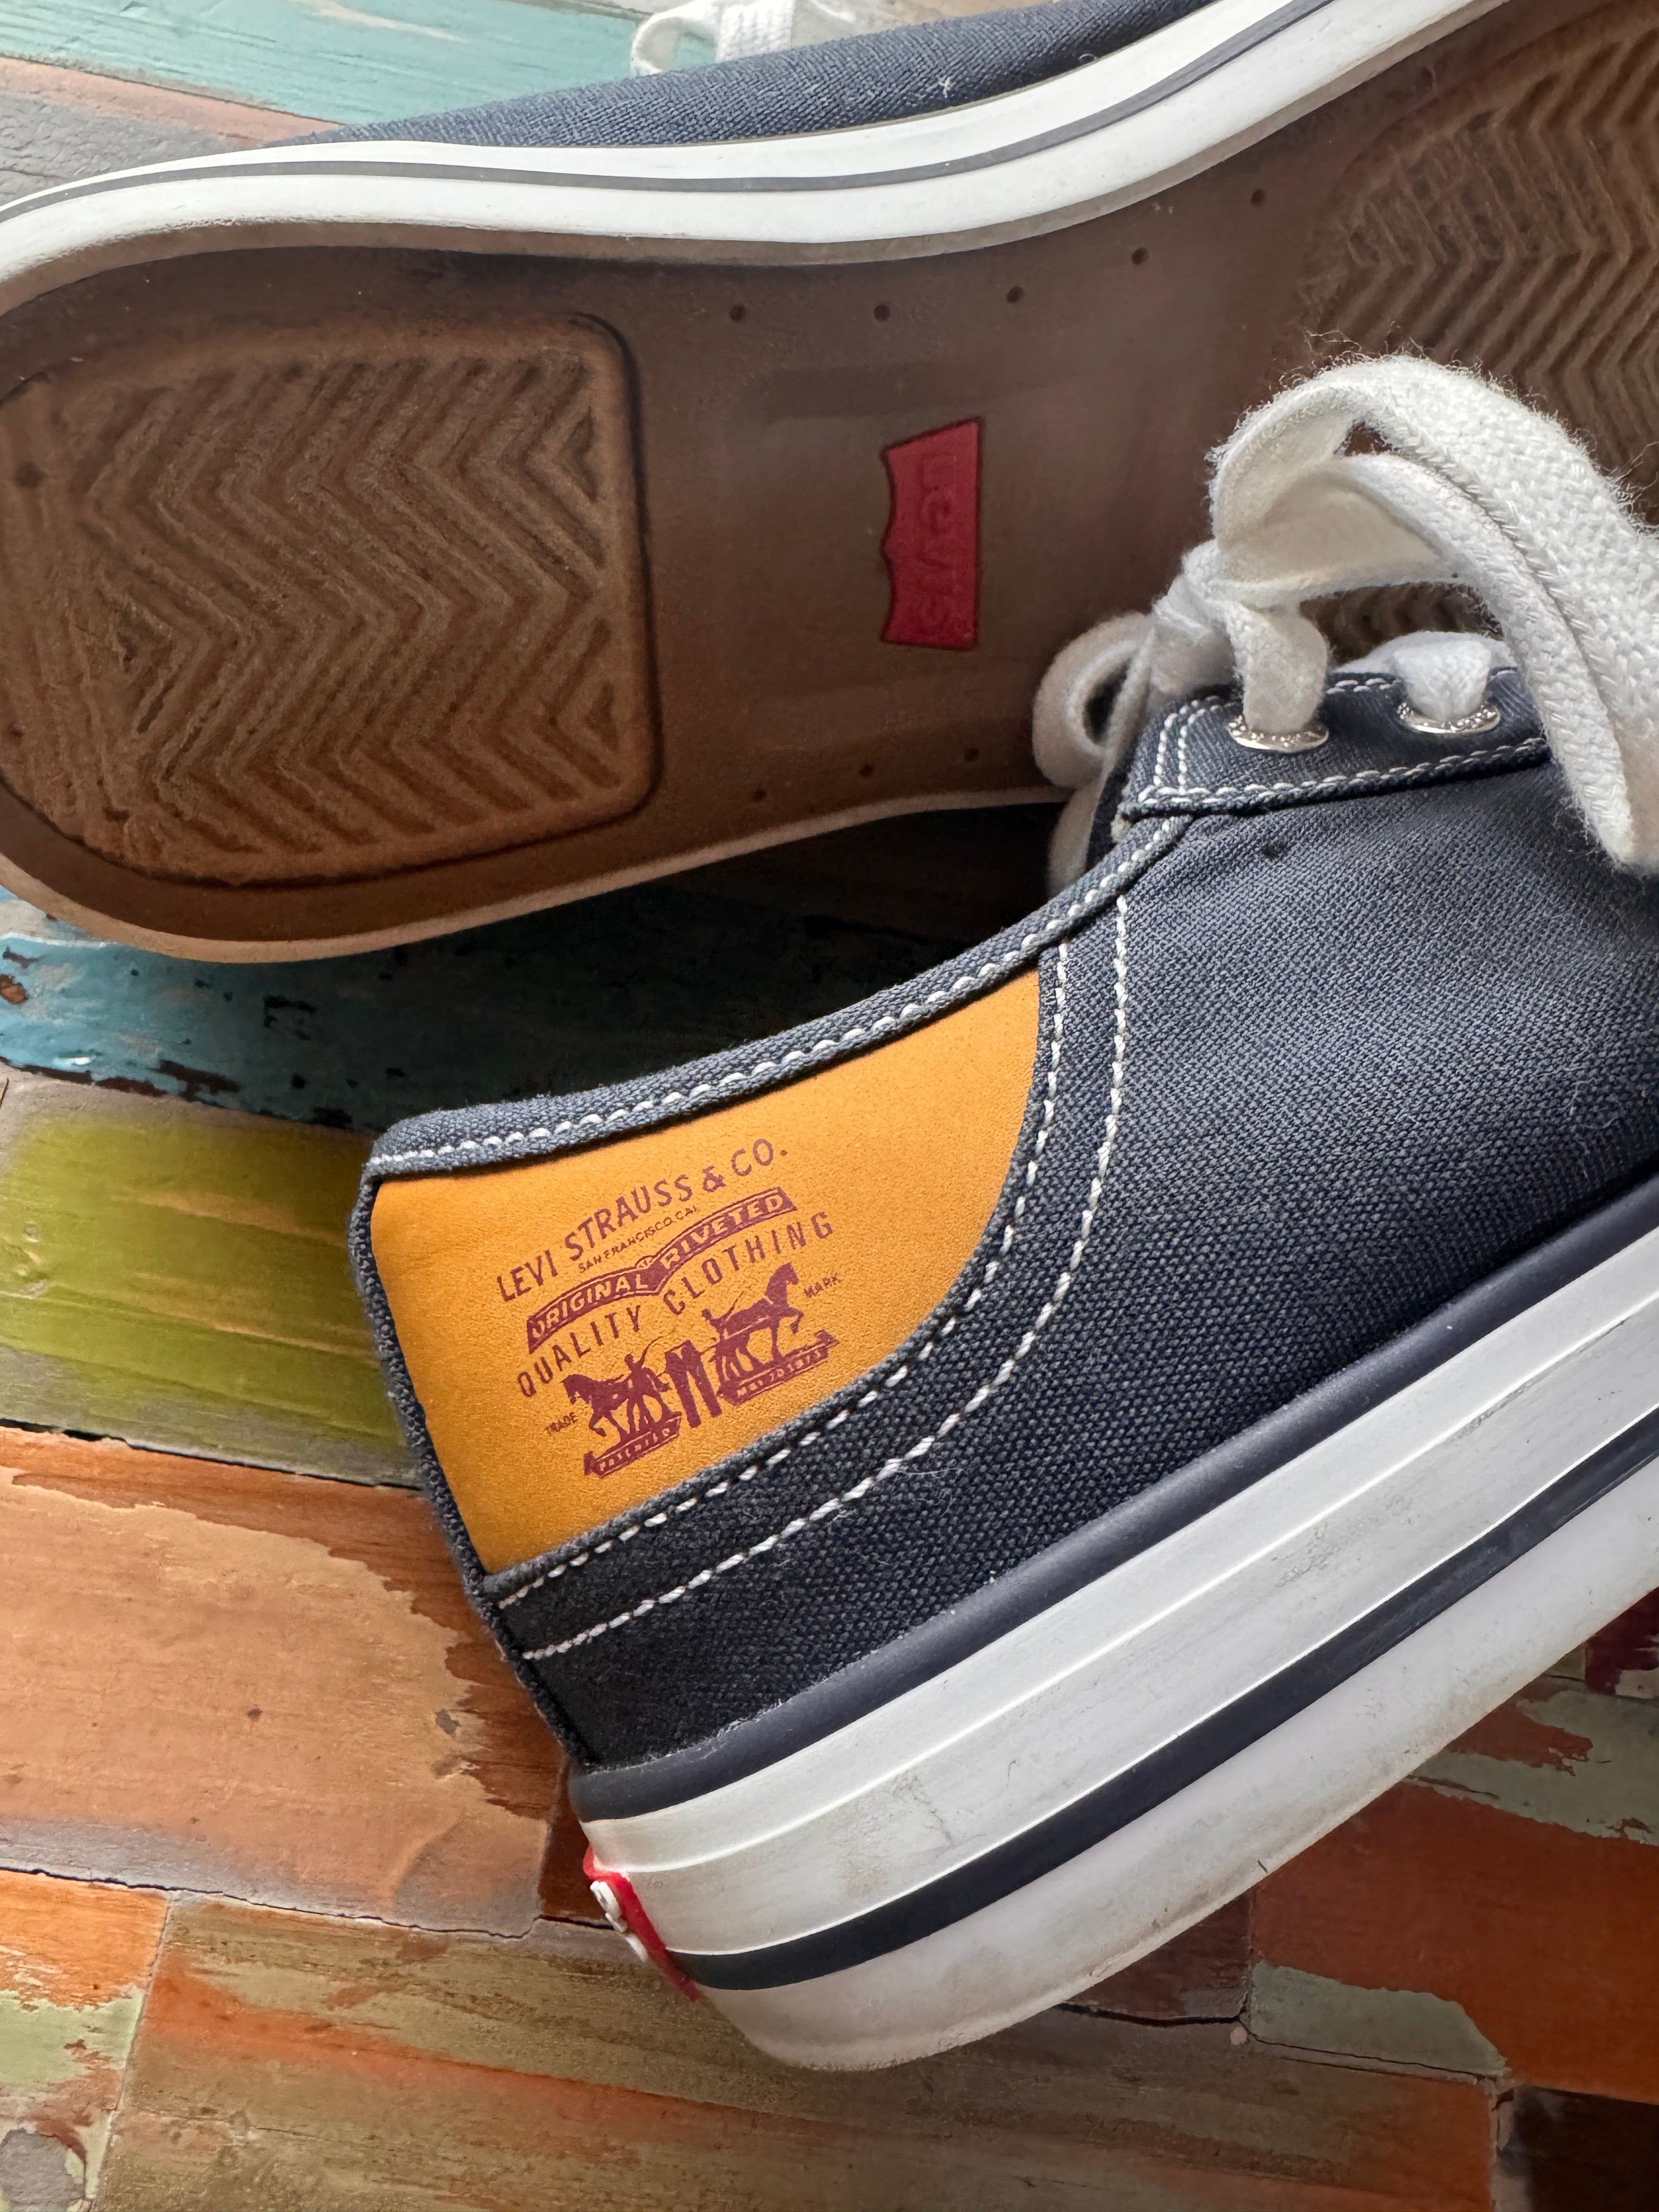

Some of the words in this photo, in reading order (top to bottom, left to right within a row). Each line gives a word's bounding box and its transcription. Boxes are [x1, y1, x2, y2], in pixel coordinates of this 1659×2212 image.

[496, 1249, 558, 1302] LEVI
[564, 1173, 693, 1261] STRAUSS
[702, 1165, 727, 1193] &
[731, 1138, 788, 1177] CO.
[531, 1273, 648, 1339] ORIGINAL
[659, 1194, 783, 1269] RIVETED
[517, 1305, 641, 1397] QUALITY
[663, 1211, 833, 1316] CLOTHING
